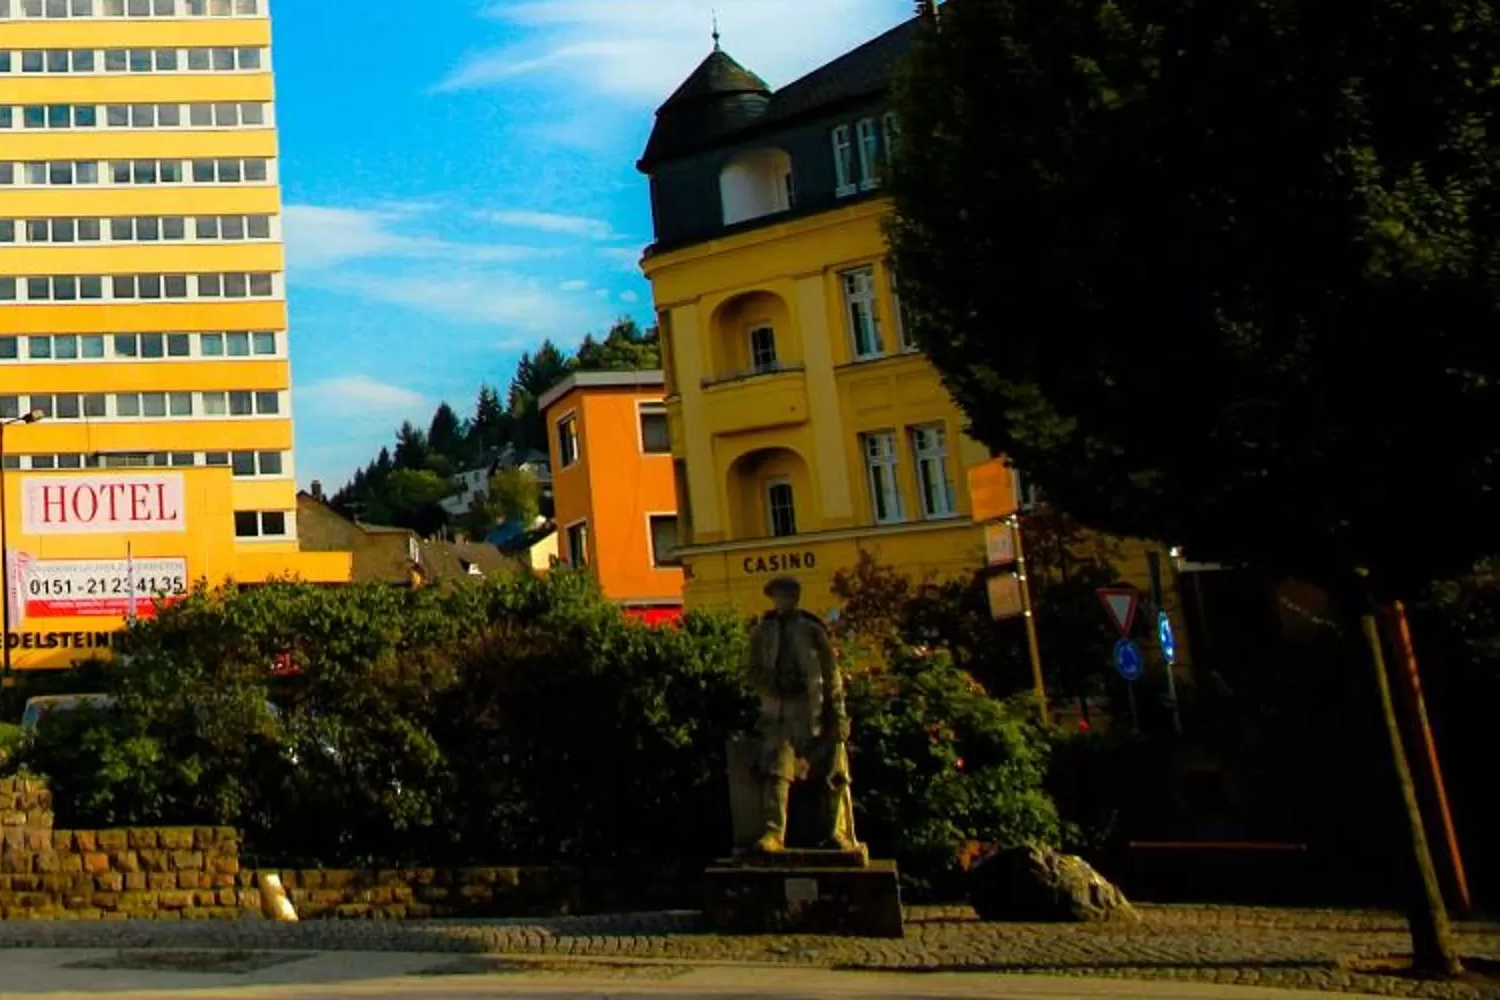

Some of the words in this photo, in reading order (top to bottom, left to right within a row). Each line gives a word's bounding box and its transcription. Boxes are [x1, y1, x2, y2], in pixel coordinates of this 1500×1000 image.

[41, 482, 177, 523] HOTEL
[743, 552, 816, 573] CASINO
[30, 579, 72, 595] 0151
